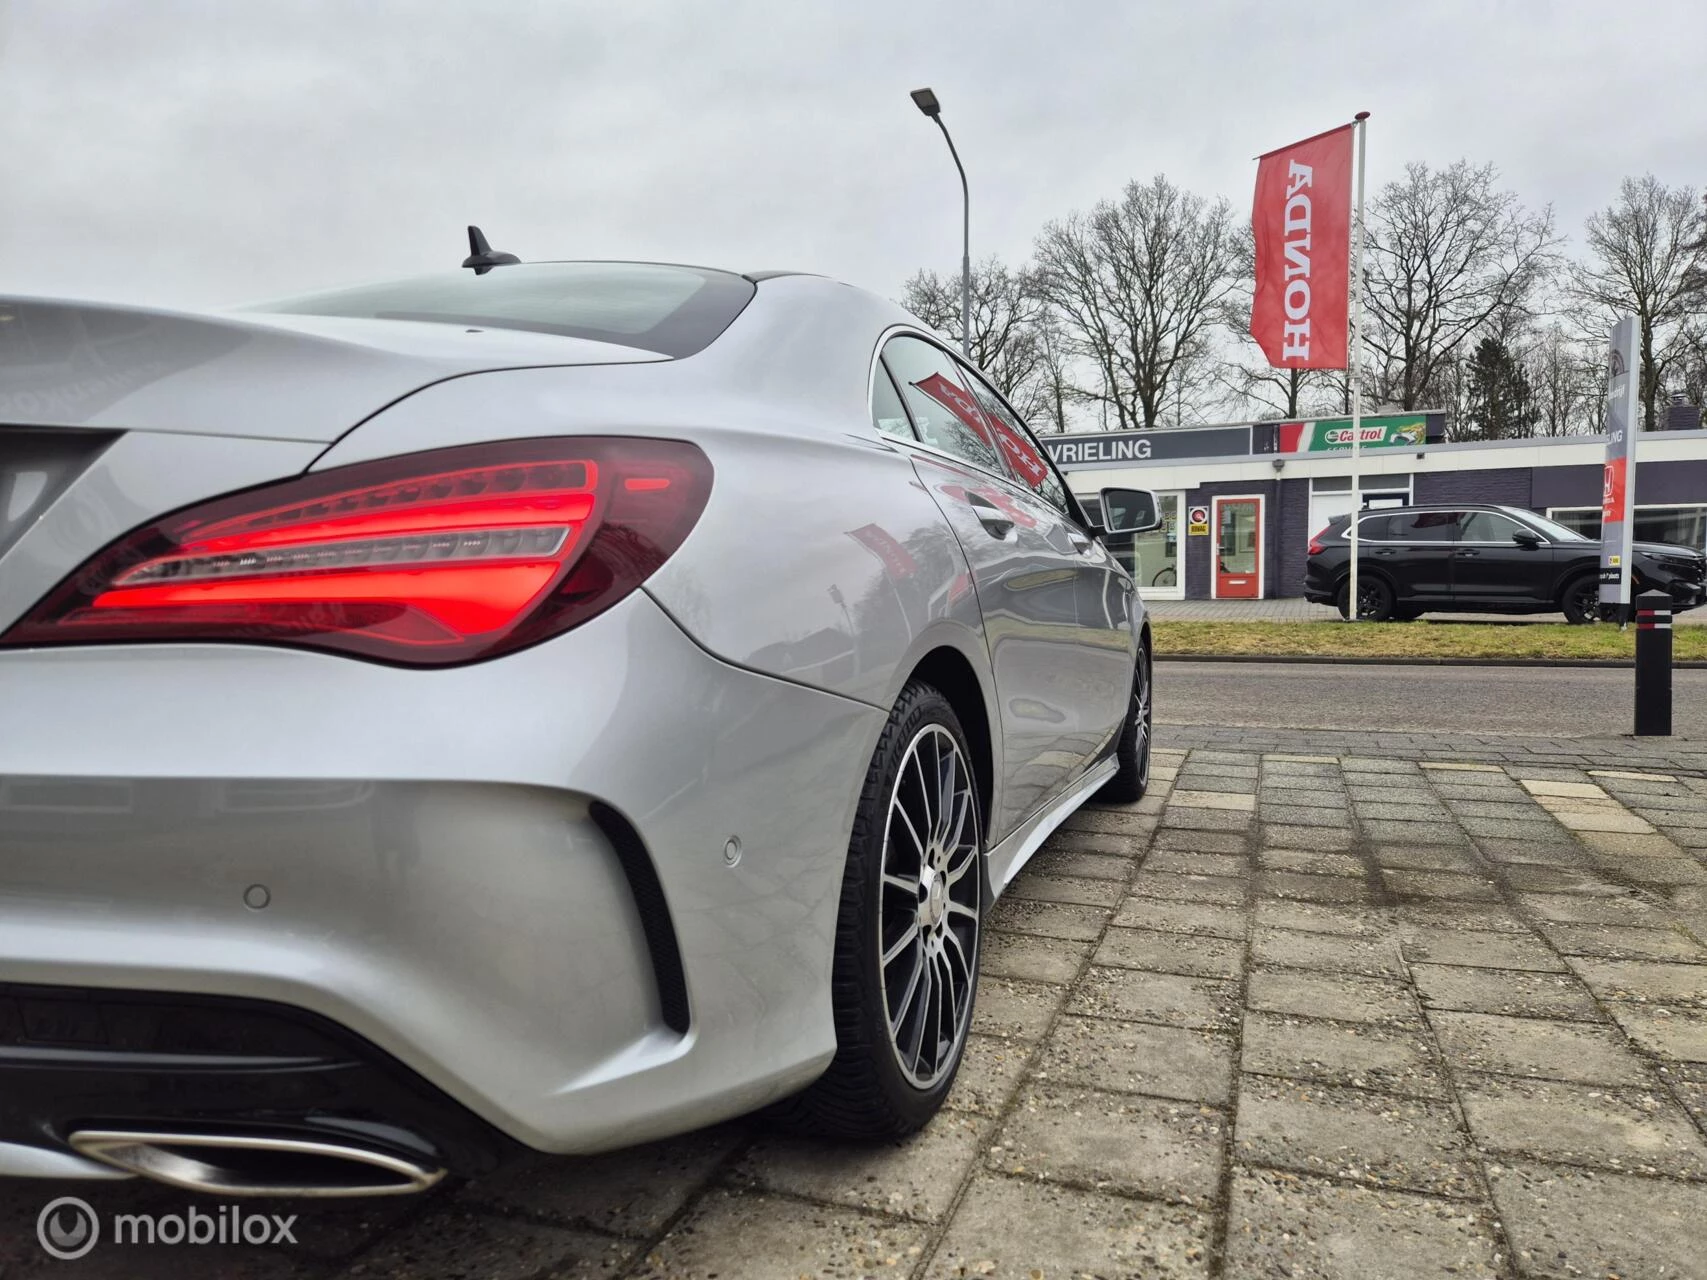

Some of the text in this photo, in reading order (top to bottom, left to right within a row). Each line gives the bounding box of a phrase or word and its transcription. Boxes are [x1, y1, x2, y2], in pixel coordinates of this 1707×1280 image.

[1282, 159, 1313, 361] HONDA
[1339, 427, 1382, 442] Catrol
[1047, 439, 1152, 462] VRIELING
